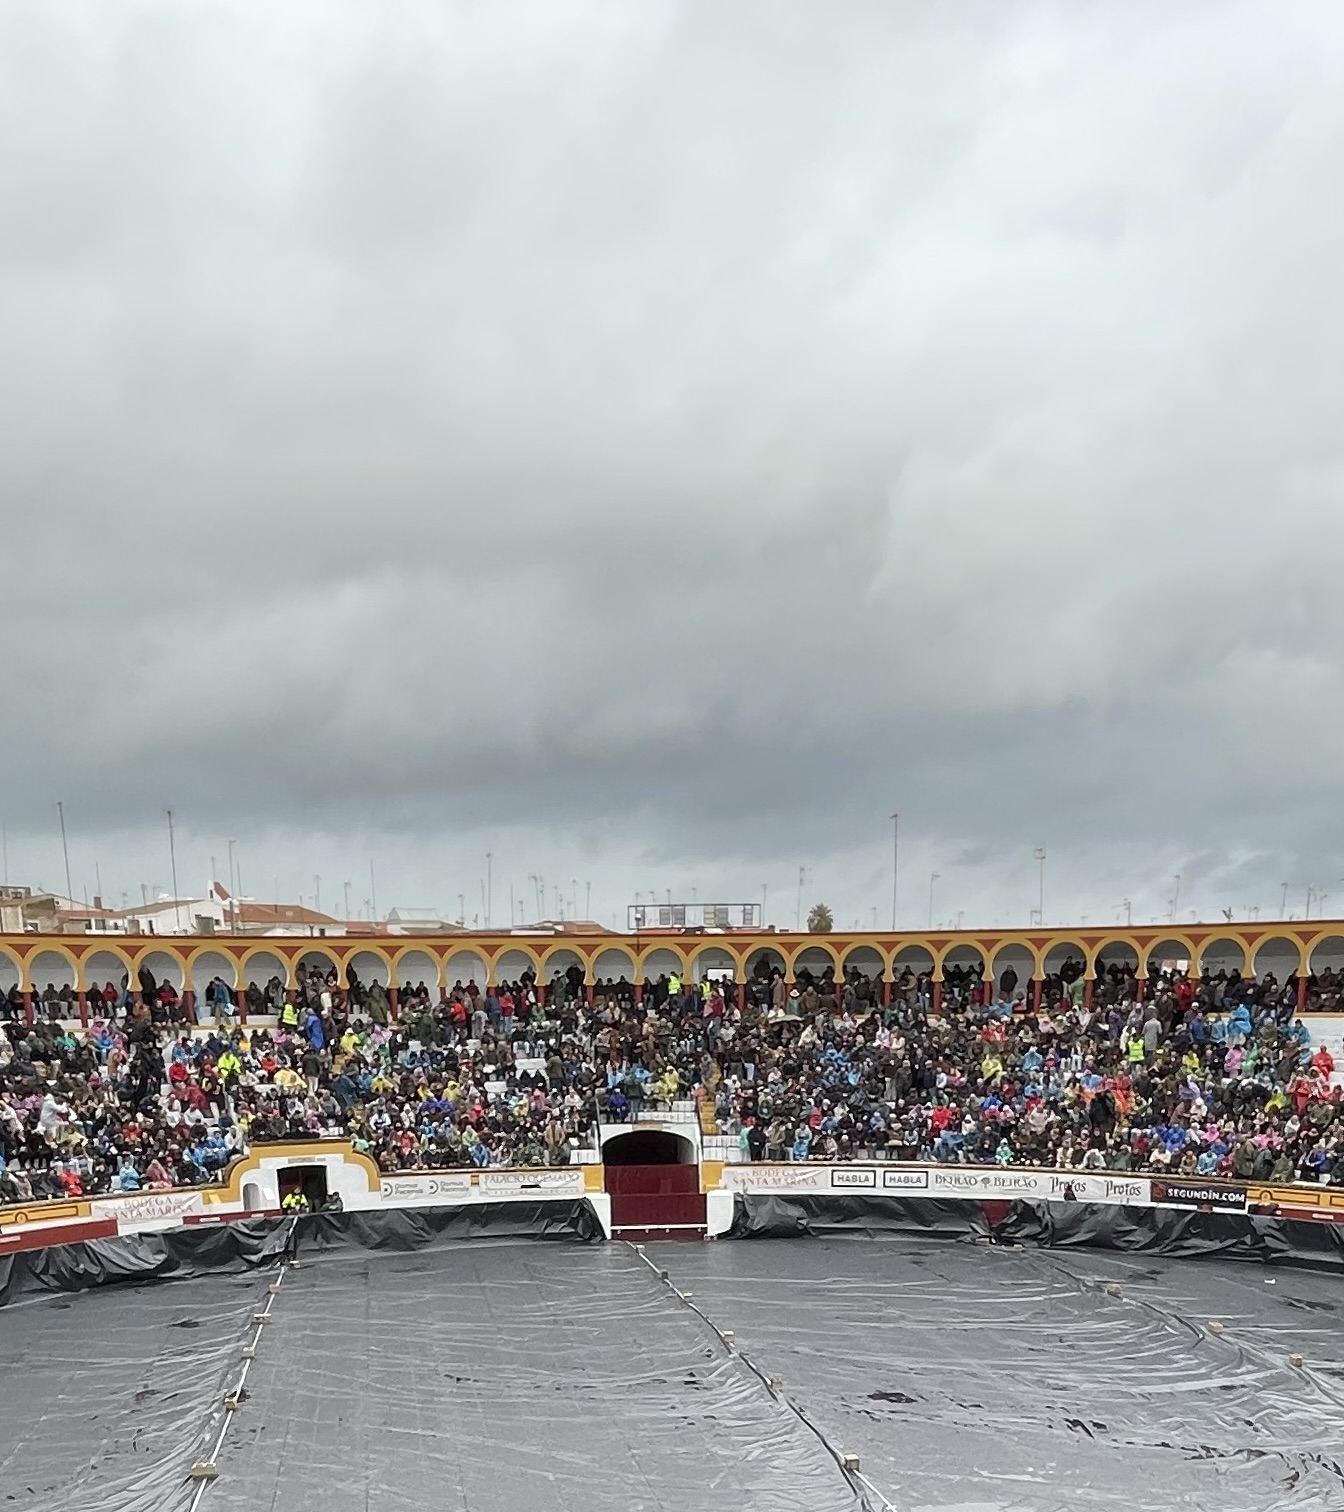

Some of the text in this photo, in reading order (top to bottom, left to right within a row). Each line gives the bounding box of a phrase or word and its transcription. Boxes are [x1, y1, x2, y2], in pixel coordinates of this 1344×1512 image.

[837, 1174, 870, 1183] HABLA
[889, 1175, 922, 1184] HABLA
[1104, 1180, 1142, 1198] Protos
[124, 1196, 173, 1210] BODEGA
